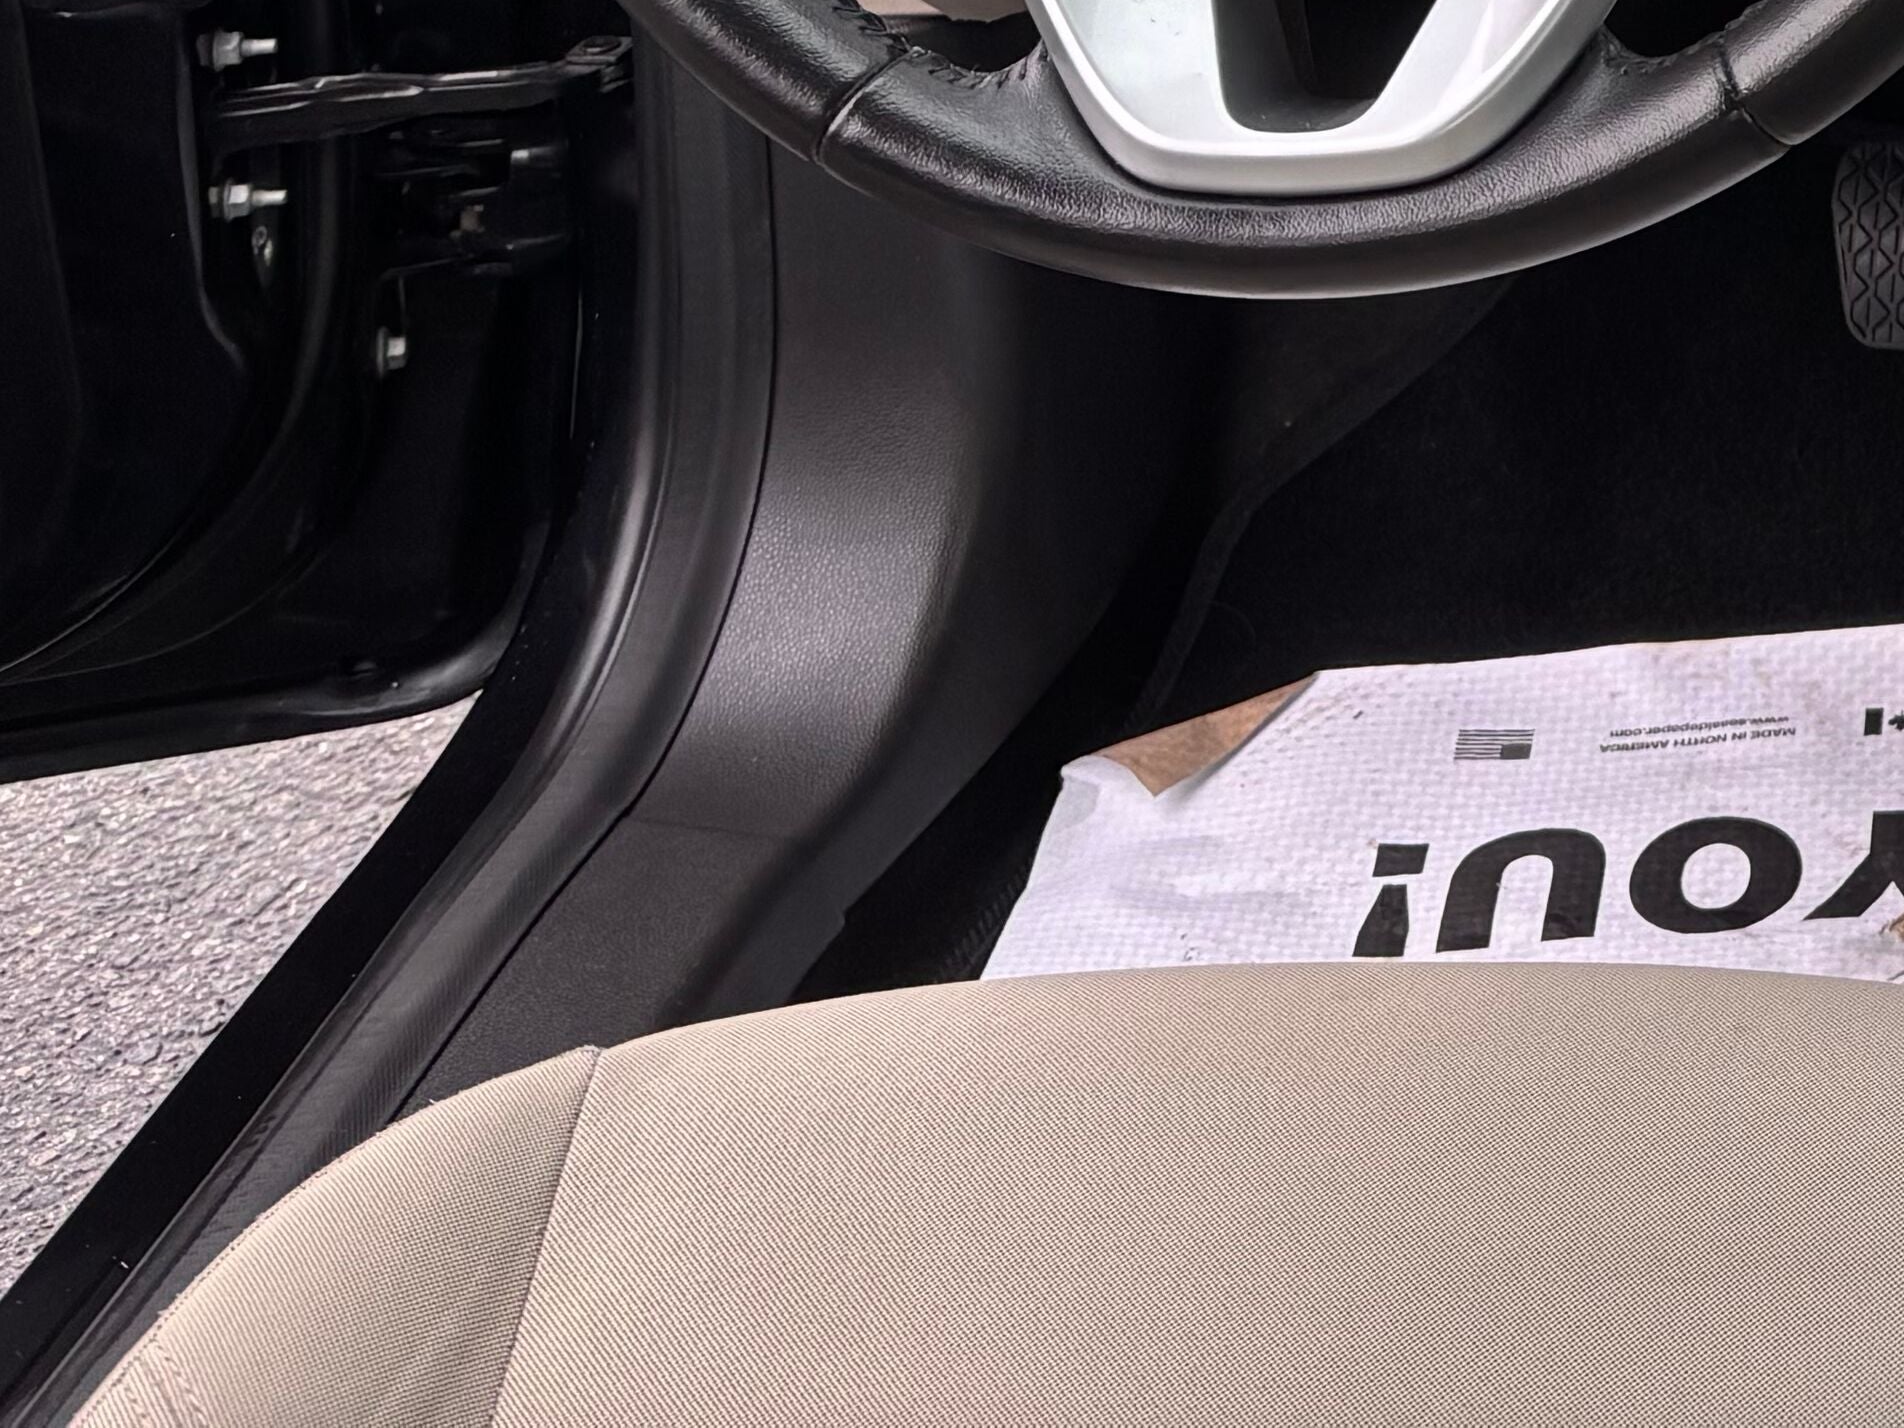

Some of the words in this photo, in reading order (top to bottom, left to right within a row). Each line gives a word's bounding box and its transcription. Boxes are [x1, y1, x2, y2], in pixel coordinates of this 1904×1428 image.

[1672, 733, 1729, 748] NORTH
[1731, 731, 1748, 742] IN
[1750, 727, 1797, 741] MADE
[1599, 739, 1670, 754] AMERICA
